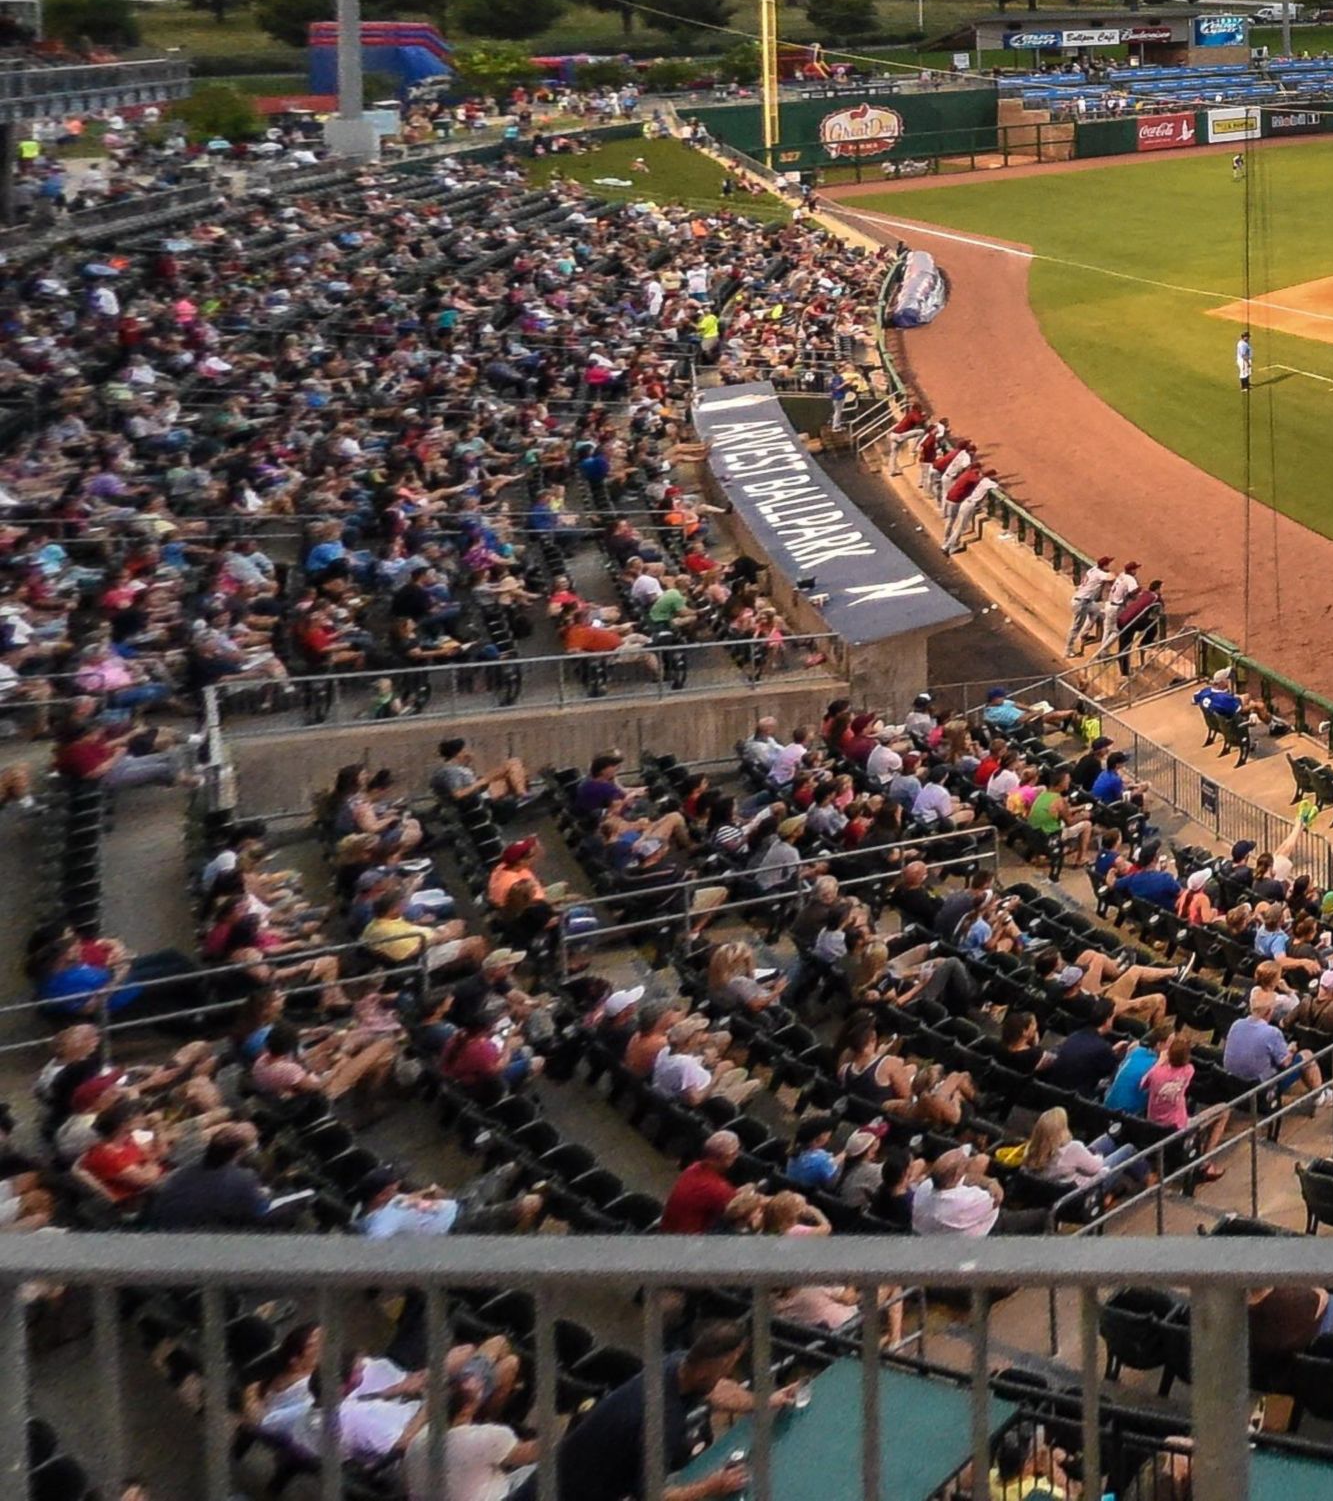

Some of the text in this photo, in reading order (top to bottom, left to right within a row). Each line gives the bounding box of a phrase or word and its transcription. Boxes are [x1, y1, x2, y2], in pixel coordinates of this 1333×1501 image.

[1121, 29, 1171, 40] Budweiser
[1272, 114, 1306, 127] Mobil
[1139, 123, 1175, 139] Coca-Cola
[710, 420, 876, 570] ARVEST BALLPARK
